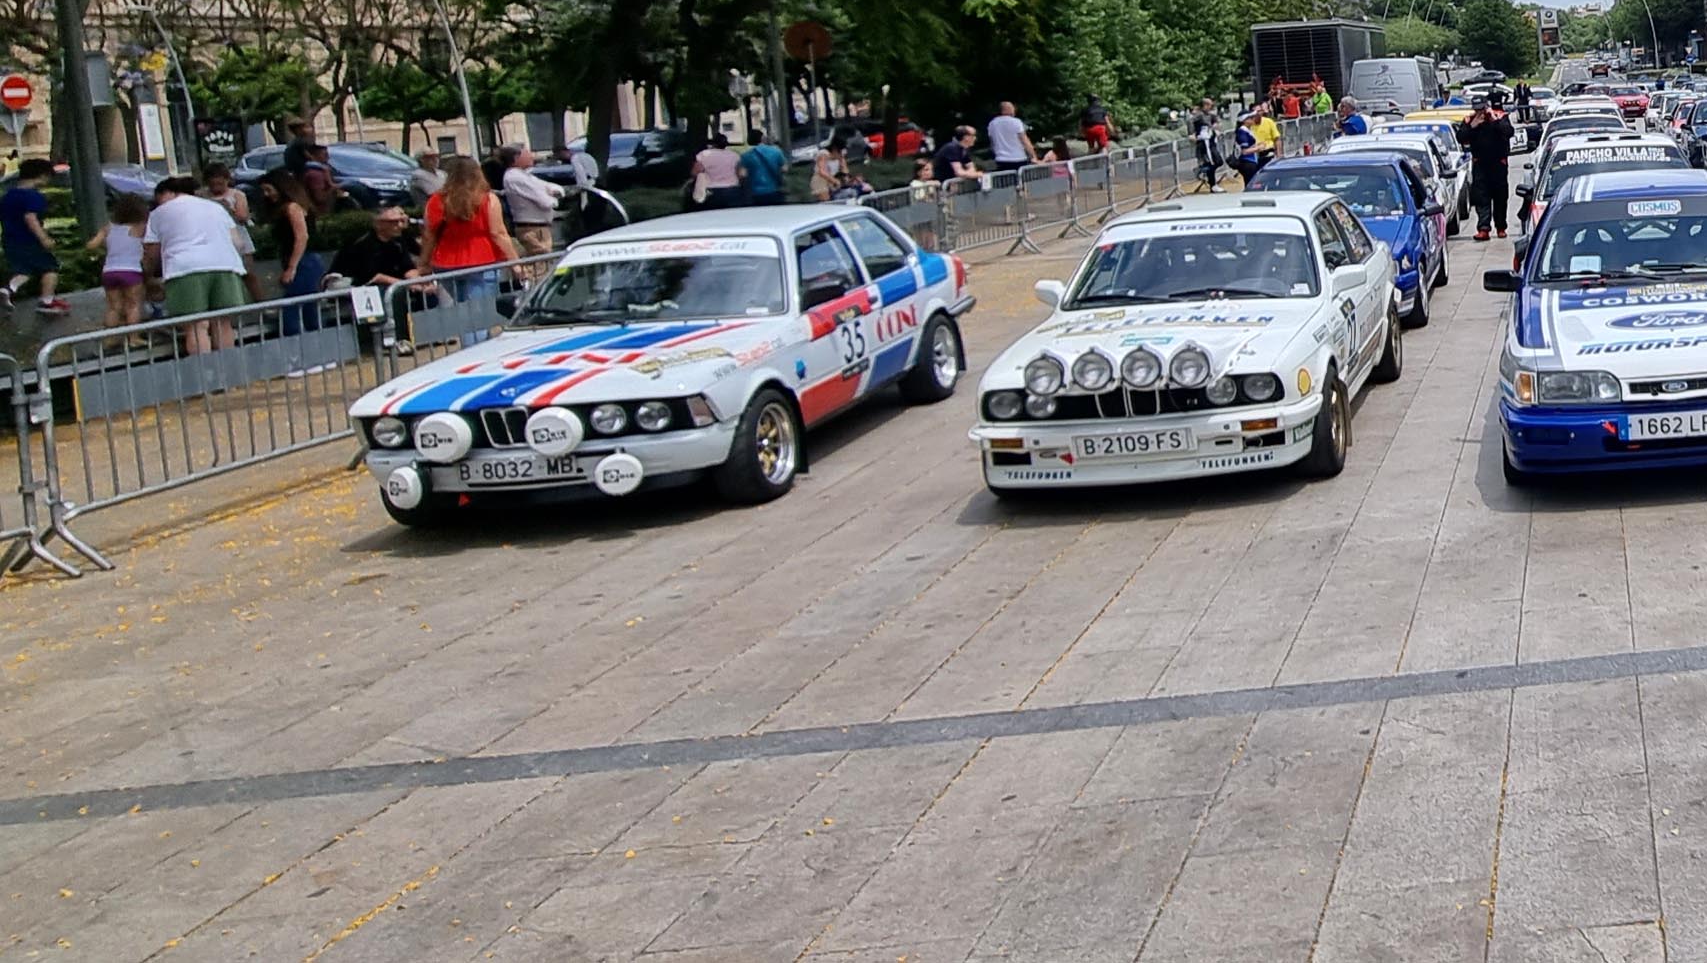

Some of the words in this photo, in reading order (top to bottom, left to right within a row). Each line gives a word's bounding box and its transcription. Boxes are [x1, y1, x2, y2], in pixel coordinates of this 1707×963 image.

[1566, 148, 1612, 163] PANCHO
[1614, 147, 1648, 158] VILLA
[1629, 201, 1679, 215] COSMOS
[365, 296, 374, 313] 4
[1063, 314, 1275, 335] TELEFUNKEN
[1632, 311, 1706, 327] Ford
[841, 319, 866, 364] 35
[1637, 416, 1684, 436] 1662
[1201, 453, 1270, 469] TELEFUNKEN
[1005, 470, 1073, 481] TELEFUNKEN
